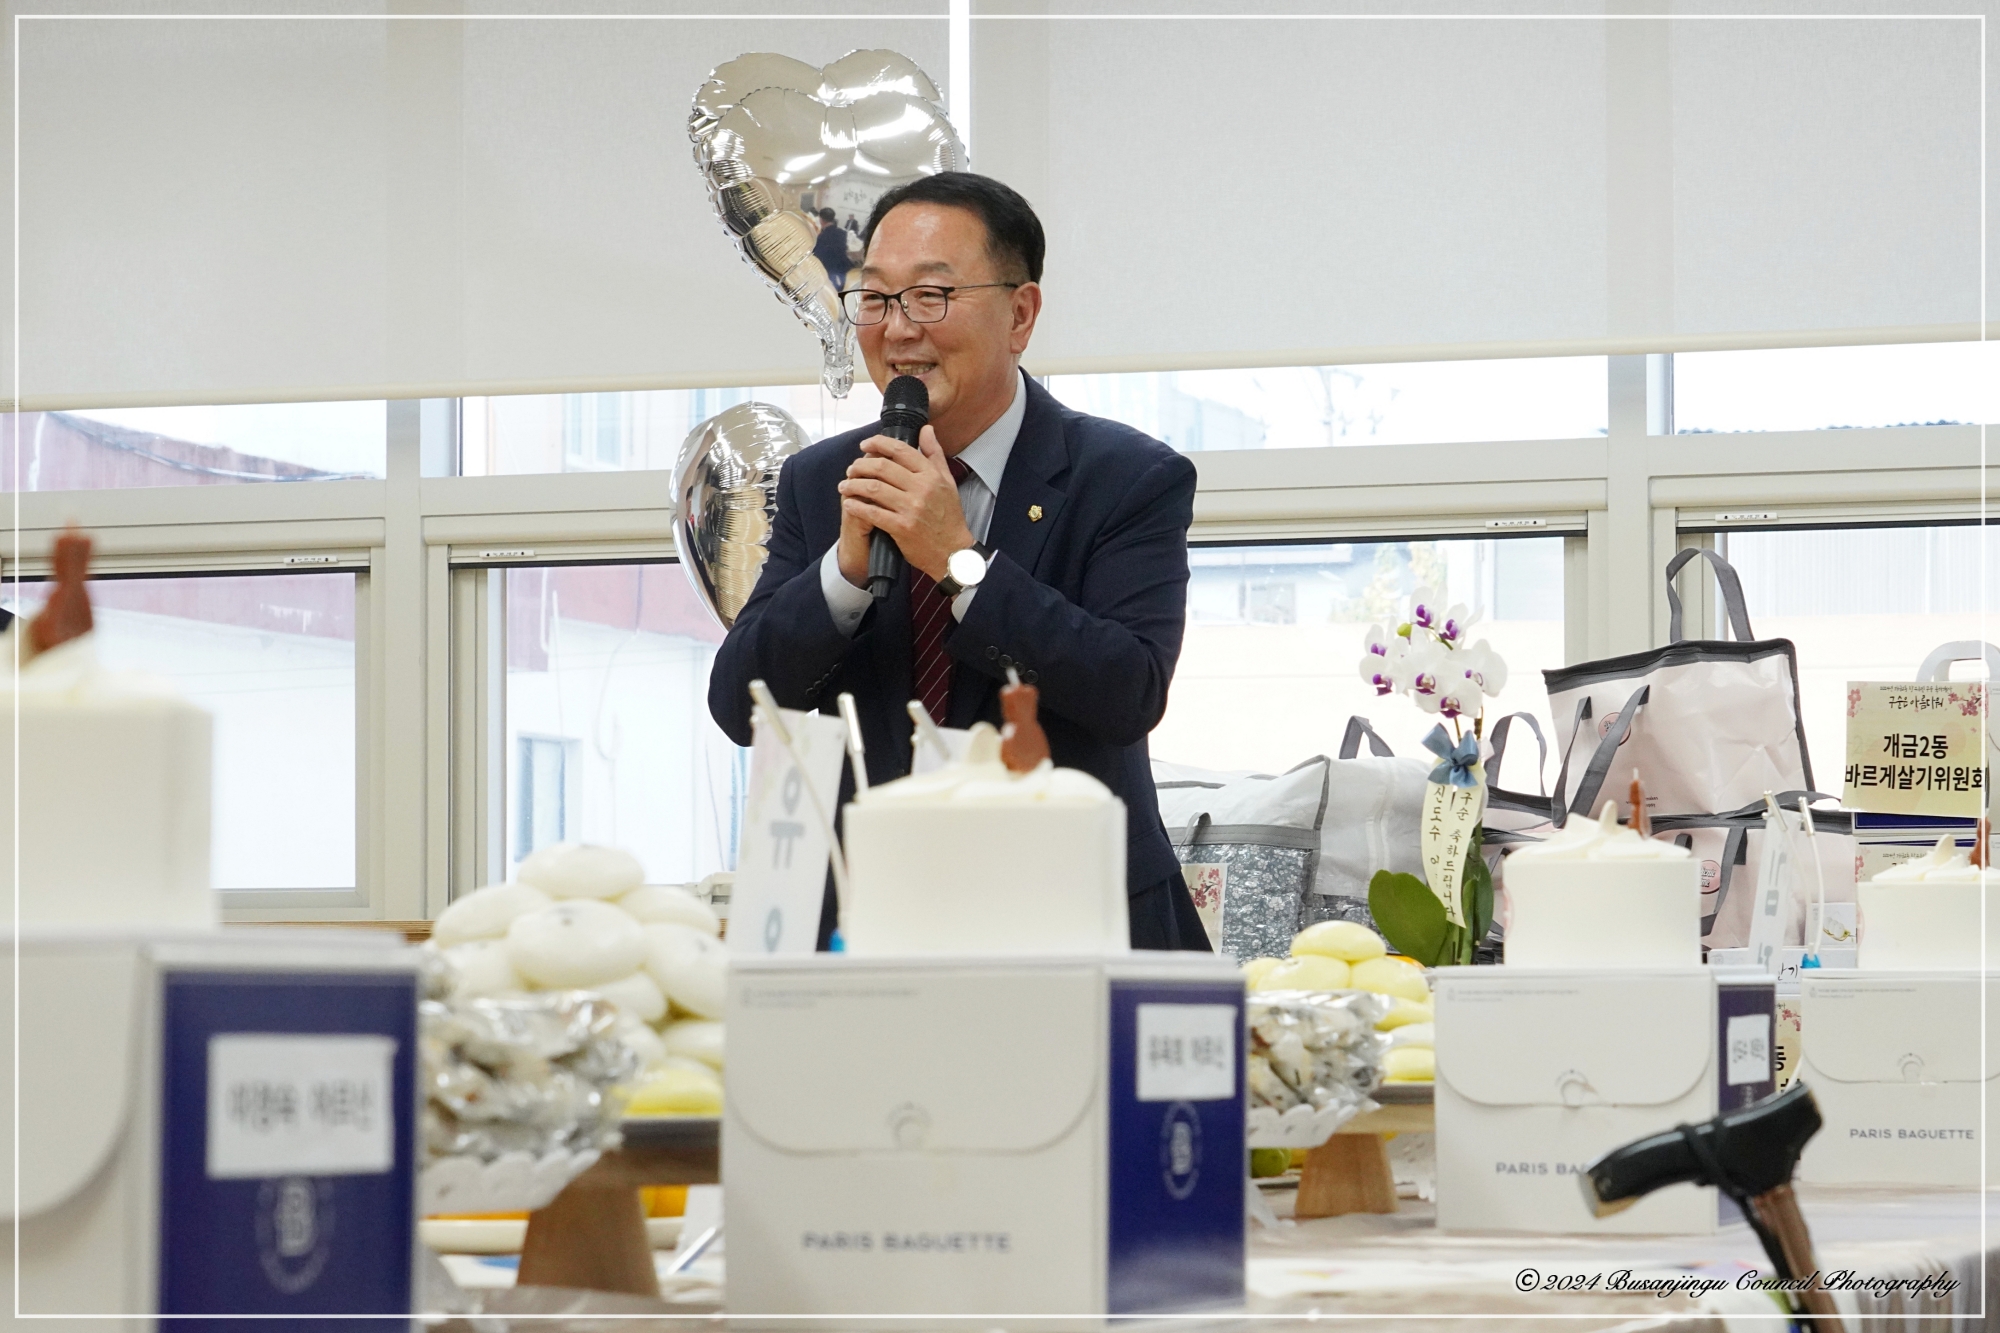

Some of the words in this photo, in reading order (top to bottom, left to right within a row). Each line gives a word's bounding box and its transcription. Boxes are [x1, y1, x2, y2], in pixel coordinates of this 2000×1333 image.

[1910, 694, 1944, 710] 아름다워
[1883, 733, 1949, 759] 개금2동
[1845, 764, 1988, 791] 바르게살기위원회
[1429, 786, 1446, 842] 신도수
[1456, 792, 1473, 821] 구순
[1850, 1129, 1892, 1140] PARIS
[1898, 1129, 1974, 1140] BAGUETTE
[1495, 1162, 1548, 1175] PARIS
[802, 1231, 873, 1252] PARIS
[882, 1231, 1012, 1254] BAGUETTE
